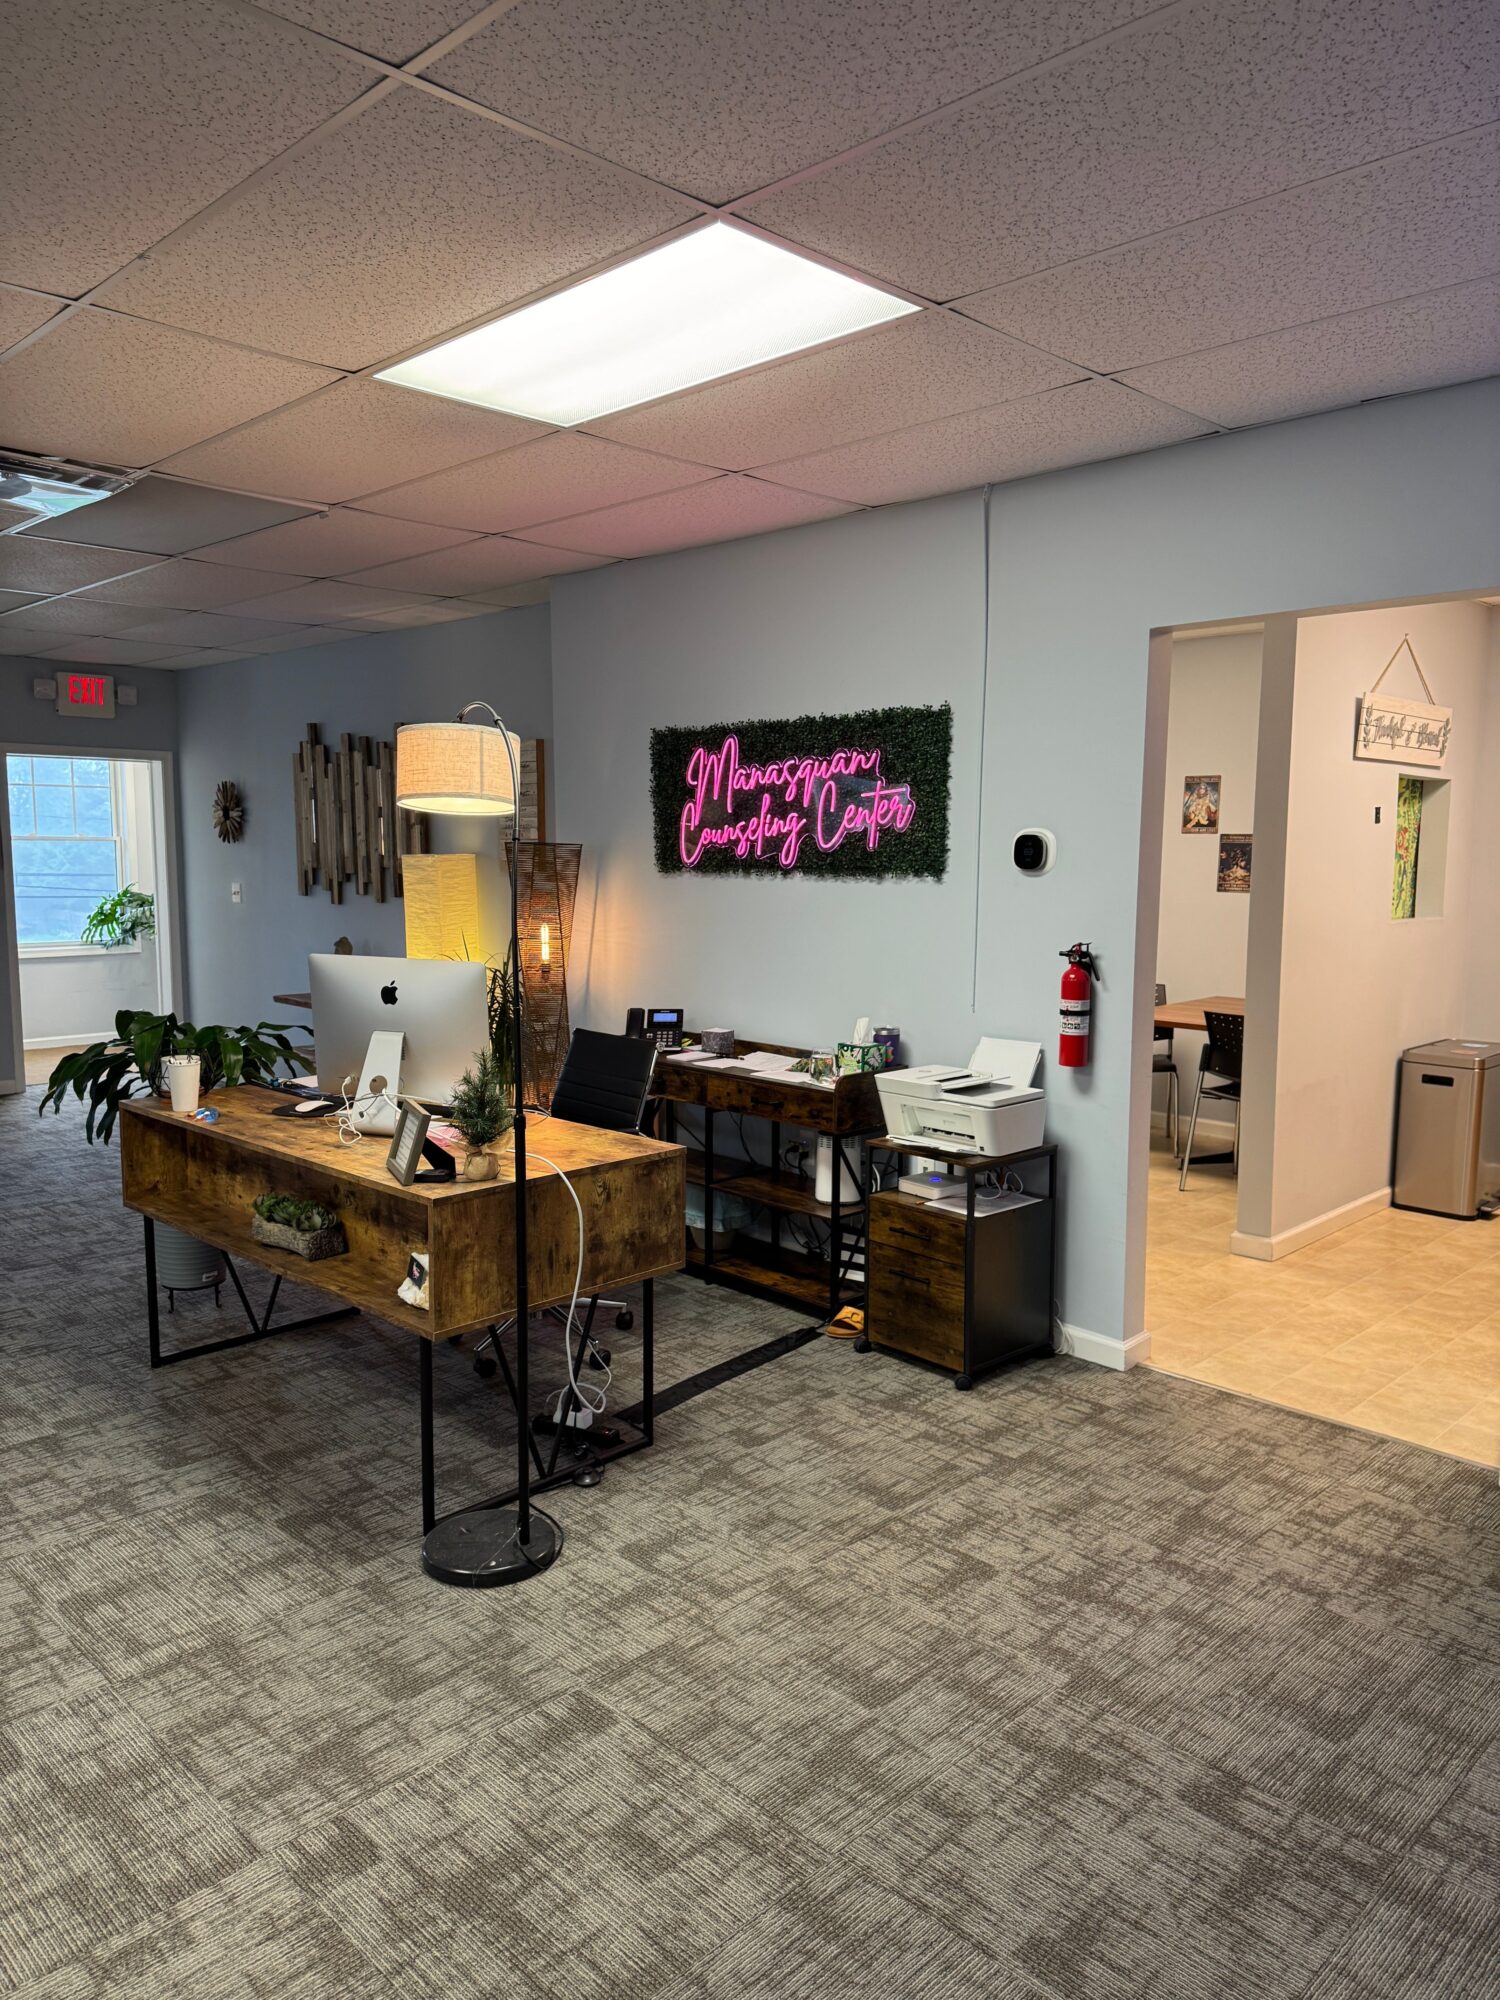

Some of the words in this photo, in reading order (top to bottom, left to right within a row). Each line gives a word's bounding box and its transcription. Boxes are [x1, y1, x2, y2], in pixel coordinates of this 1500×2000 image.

[69, 675, 105, 704] EXIT
[681, 794, 806, 866] Counseling
[817, 781, 912, 849] Center
[686, 737, 880, 826] Manasquan
